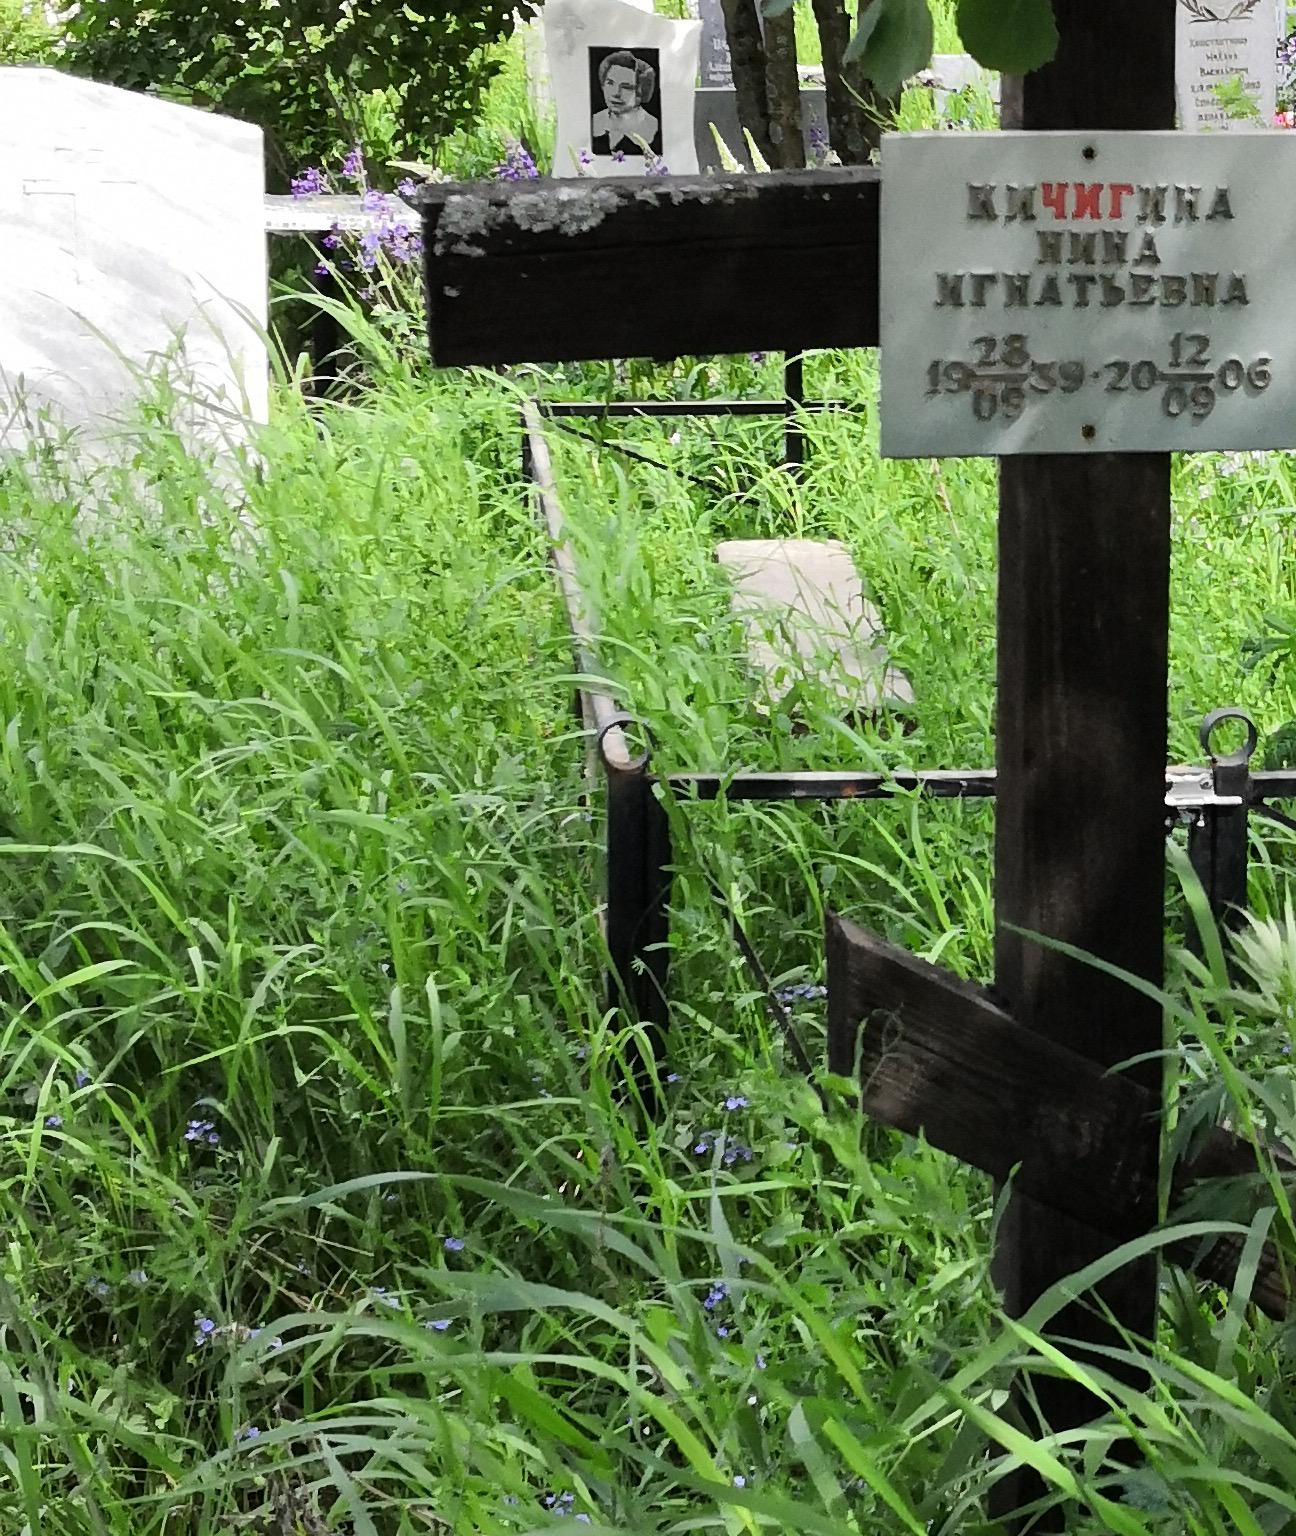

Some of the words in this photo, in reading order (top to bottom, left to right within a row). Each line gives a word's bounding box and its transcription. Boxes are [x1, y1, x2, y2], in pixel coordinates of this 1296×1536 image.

[966, 181, 1236, 226] КИЧИГИНА
[1034, 229, 1162, 266] НИНА
[933, 270, 1250, 308] ИГНАТЬЕВНА
[1168, 332, 1211, 367] 12
[1161, 384, 1217, 424] 09
